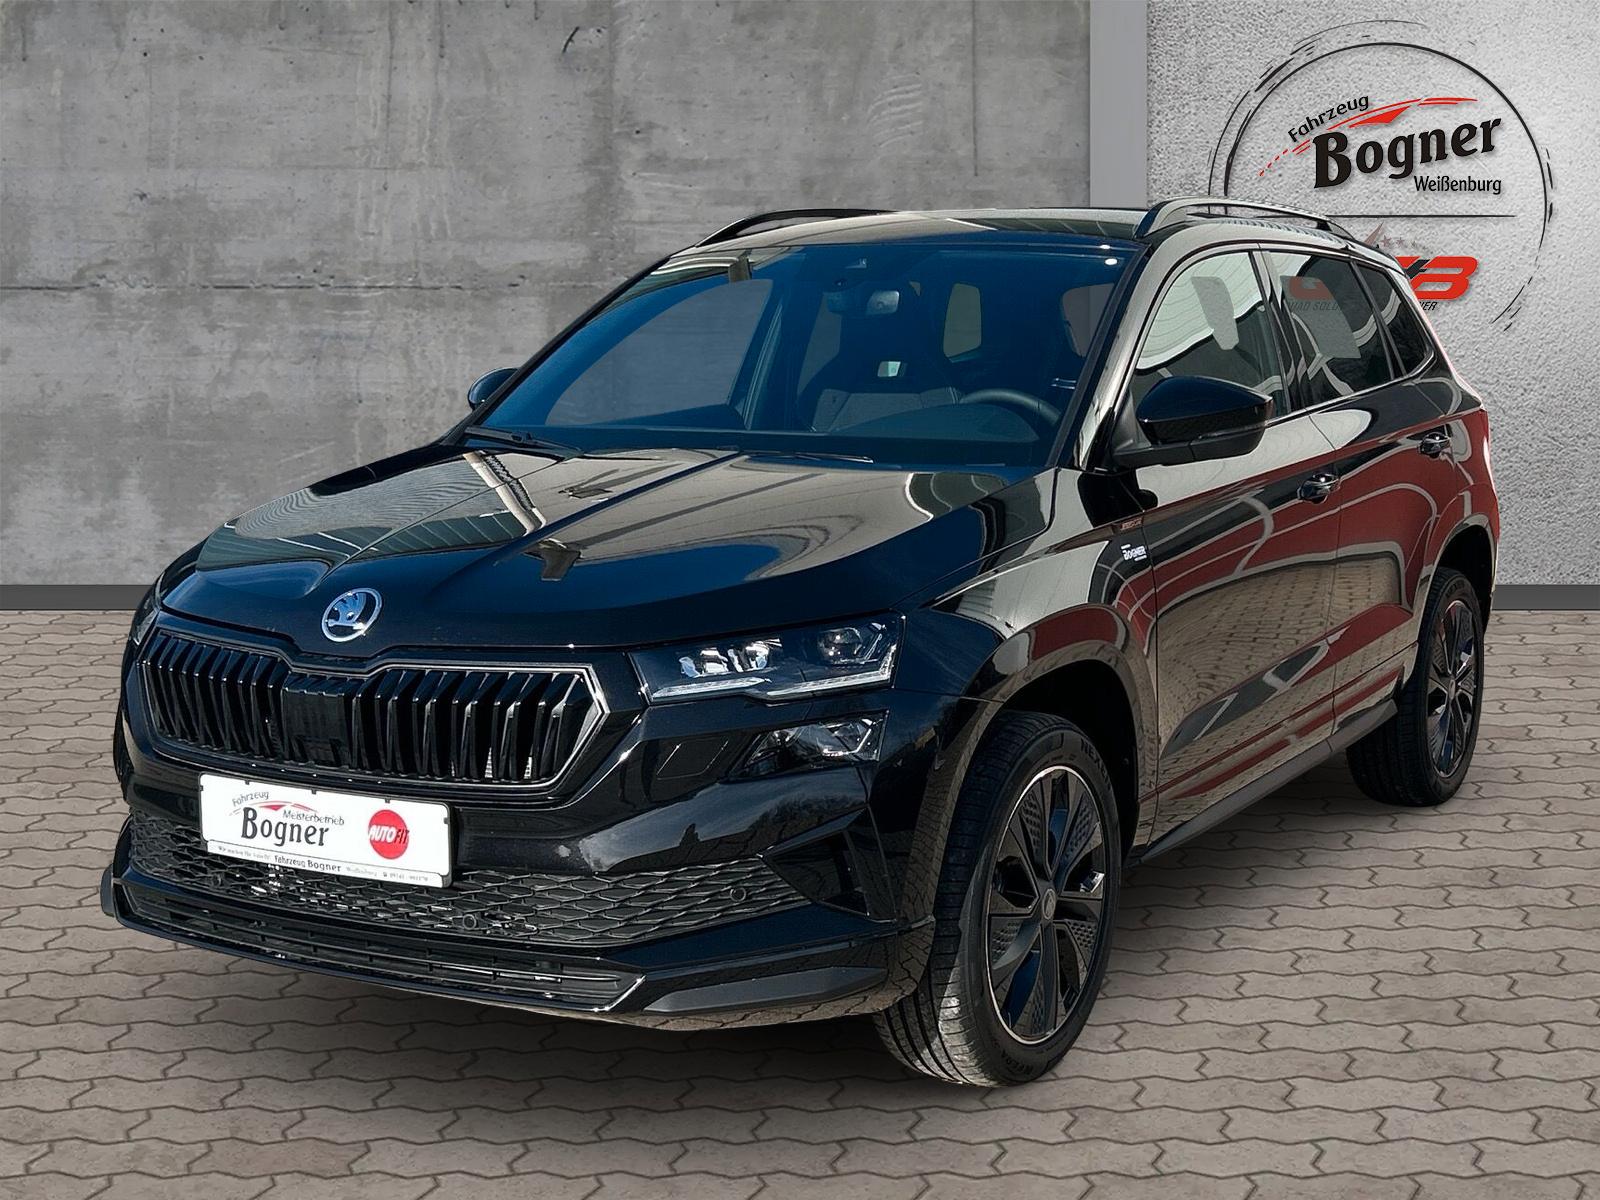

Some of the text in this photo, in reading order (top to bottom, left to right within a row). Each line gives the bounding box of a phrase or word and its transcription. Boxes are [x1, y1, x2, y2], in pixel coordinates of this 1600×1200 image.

[1287, 96, 1369, 142] Fahrzeug
[1313, 118, 1502, 189] Bogner
[1414, 175, 1502, 194] Weißenburg
[232, 791, 270, 807] Fahrzeug
[241, 807, 330, 847] Bogner
[282, 809, 345, 826] Meisterbetrieb
[307, 860, 342, 872] Bogner
